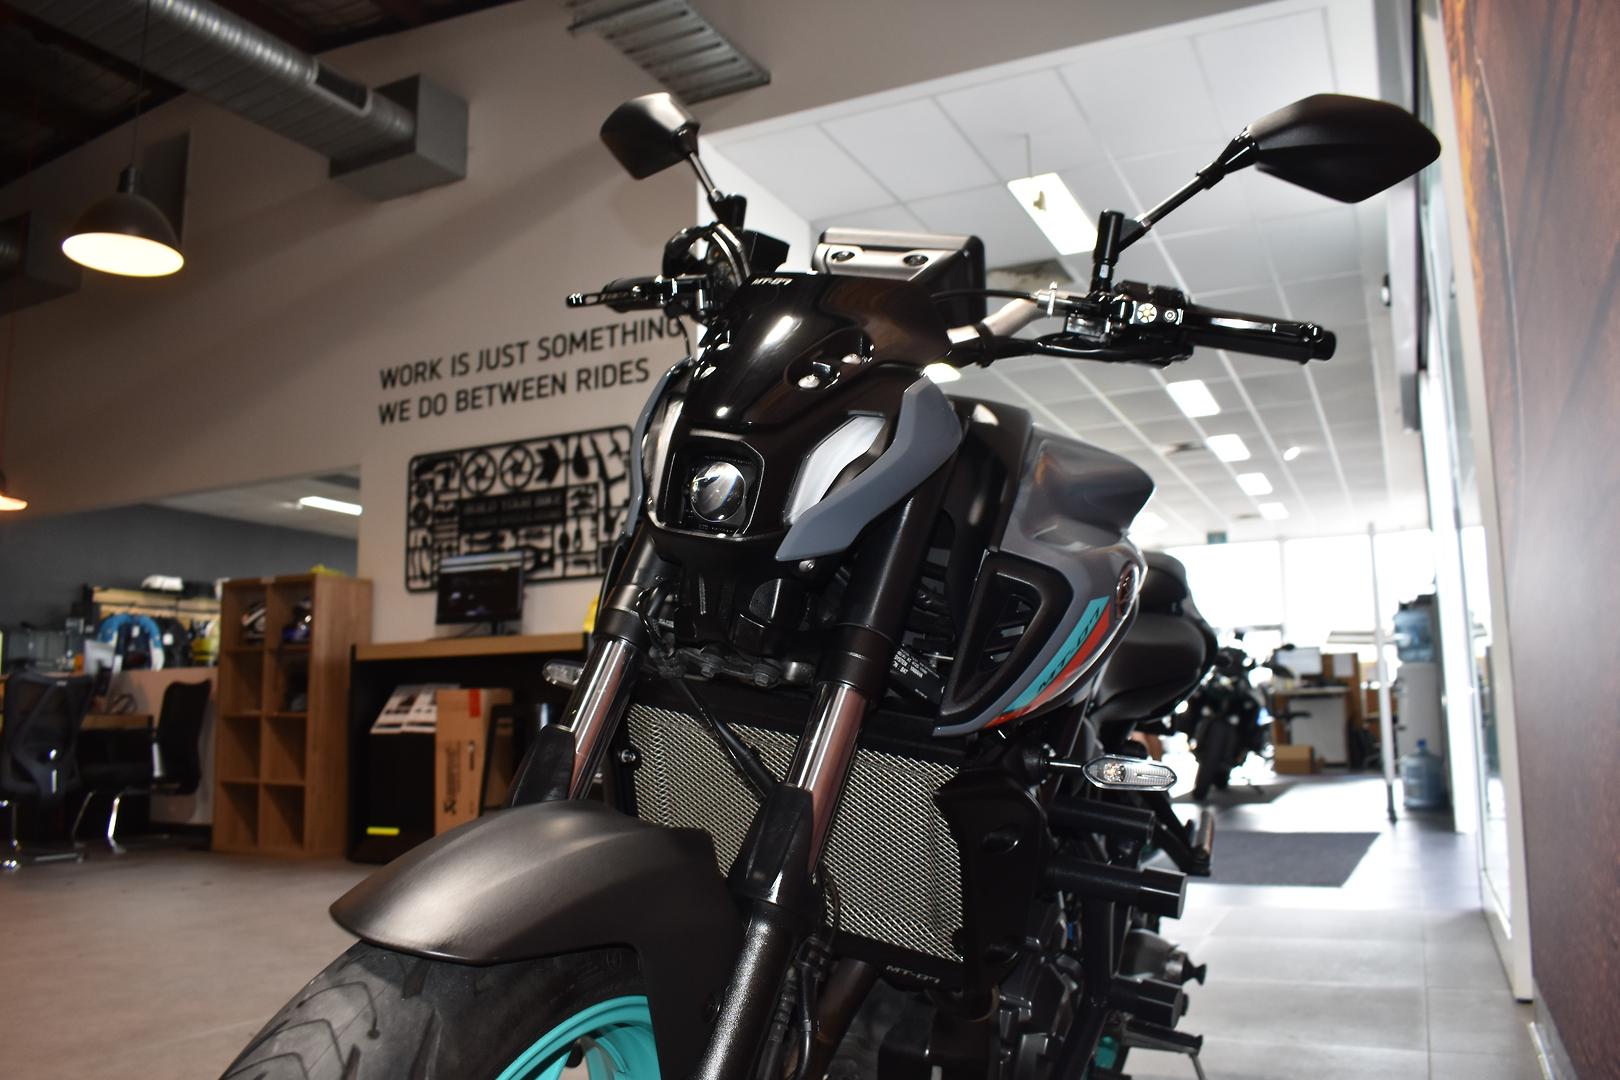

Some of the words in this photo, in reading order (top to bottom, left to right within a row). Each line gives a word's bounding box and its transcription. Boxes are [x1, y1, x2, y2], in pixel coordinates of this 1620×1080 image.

[379, 357, 443, 391] WORK
[451, 352, 470, 378] IS
[476, 340, 530, 373] JUST
[537, 316, 682, 362] SOMETHING
[378, 397, 411, 425] WE
[418, 392, 448, 419] DO
[455, 372, 567, 413] BETWEEN
[576, 357, 650, 393] RIDES
